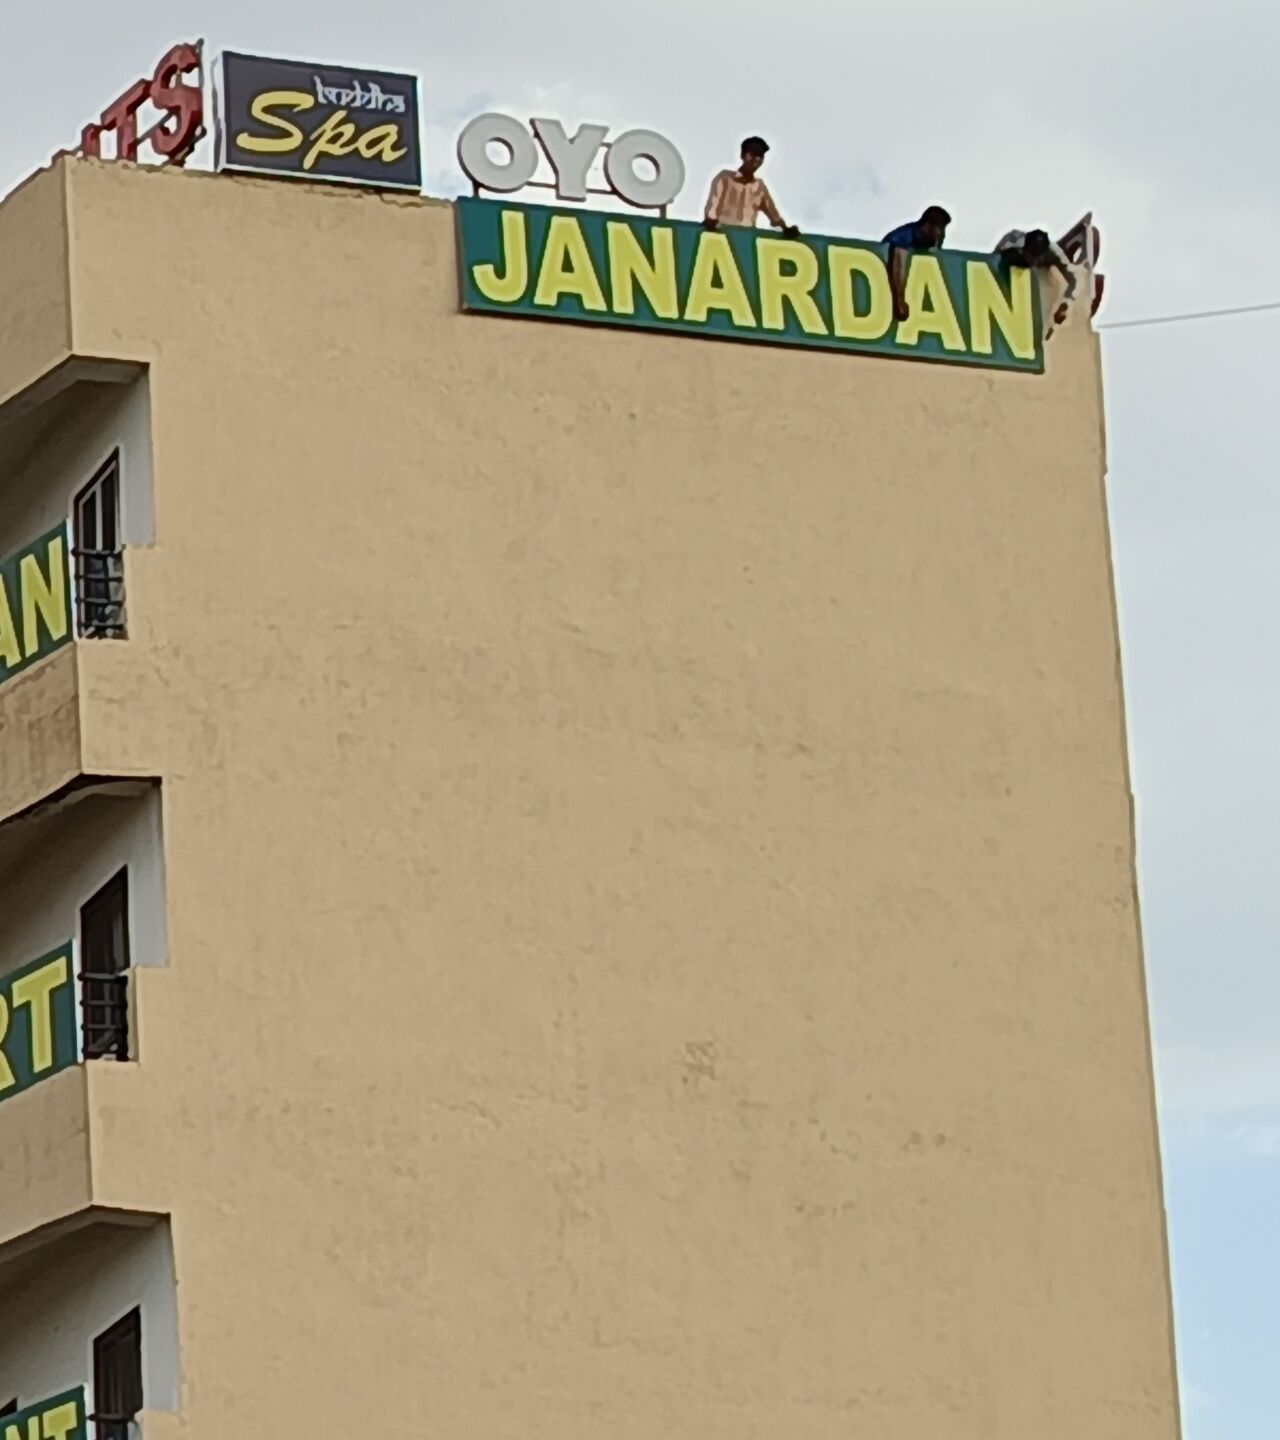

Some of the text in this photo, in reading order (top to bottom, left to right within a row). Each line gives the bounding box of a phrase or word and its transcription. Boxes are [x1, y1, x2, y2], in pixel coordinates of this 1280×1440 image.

[236, 91, 408, 170] Spa
[457, 112, 686, 208] OYO
[472, 209, 1036, 361] JANARDAN
